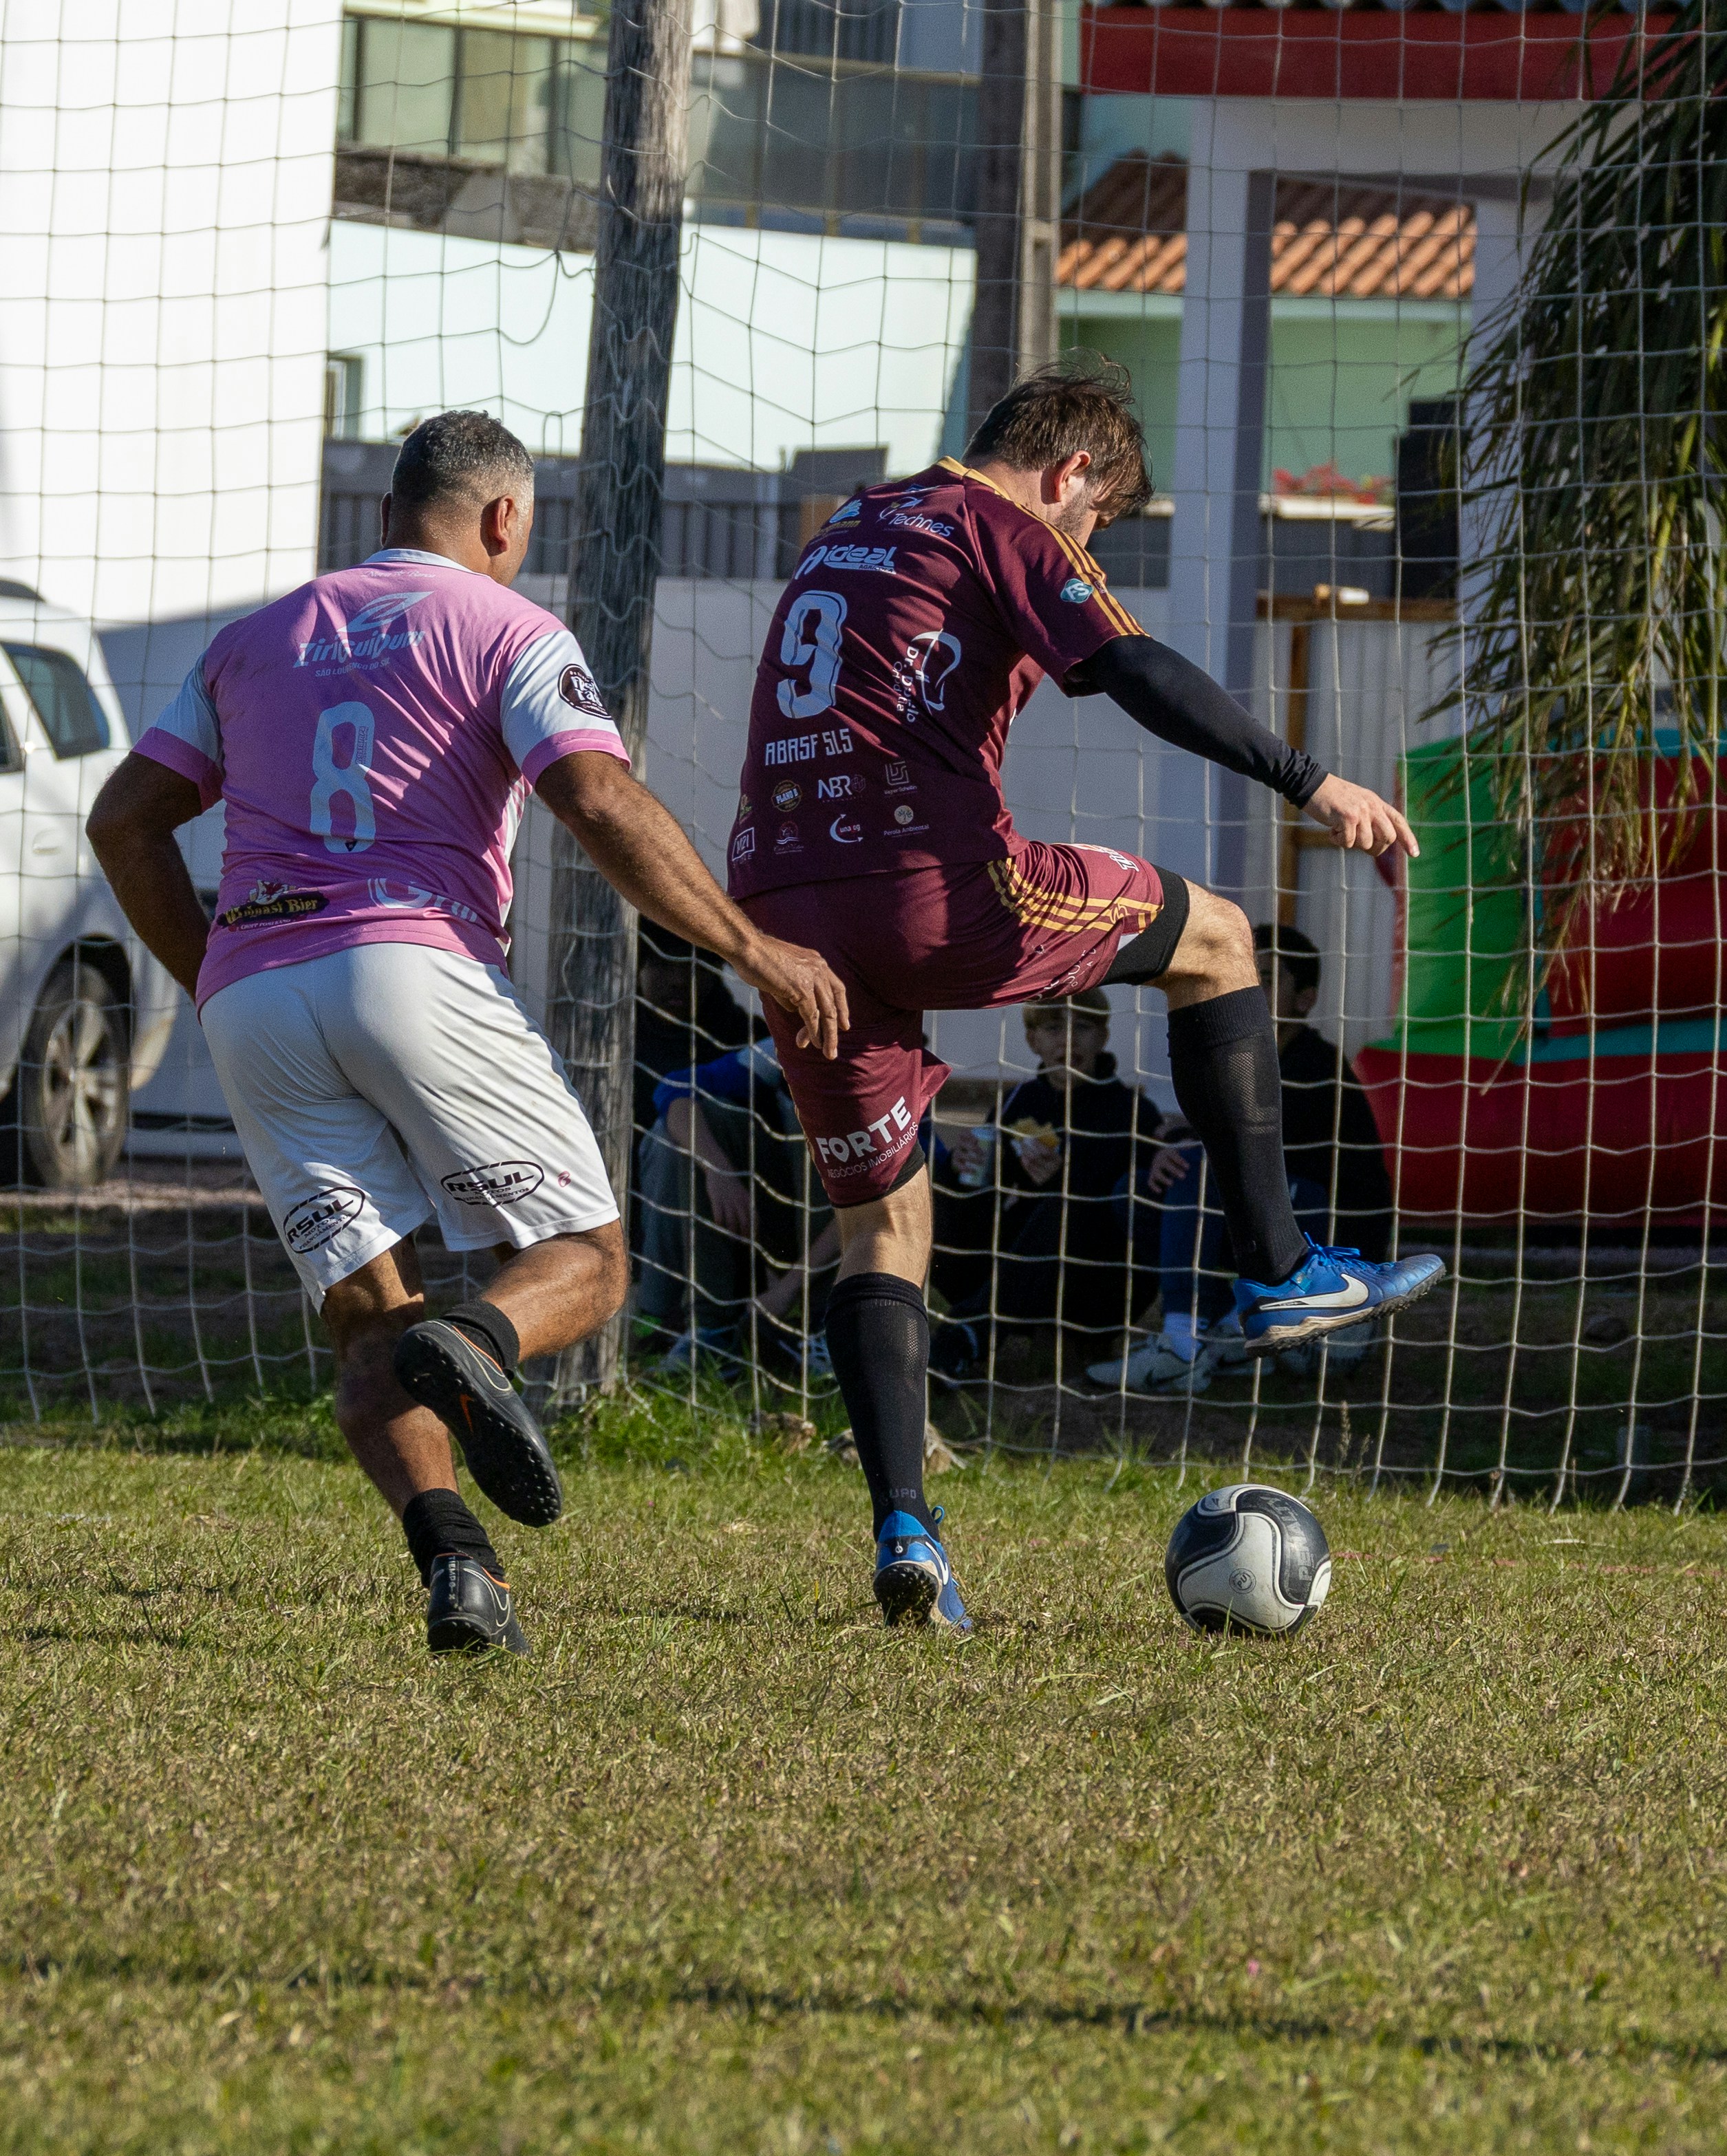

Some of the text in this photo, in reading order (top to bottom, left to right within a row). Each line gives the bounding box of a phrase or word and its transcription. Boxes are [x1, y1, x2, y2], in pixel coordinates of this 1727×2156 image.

[888, 513, 954, 537] Technes
[1064, 582, 1090, 601] FS
[776, 590, 848, 720] 9
[310, 701, 376, 854] 8
[818, 775, 852, 799] NBR
[285, 898, 318, 913] Bier
[815, 1096, 912, 1163] FORTE
[828, 1121, 919, 1178] NEGÓCIOS IMOBILIÁRIOS
[447, 1172, 535, 1192] RSUL
[287, 1199, 354, 1244] RSUL
